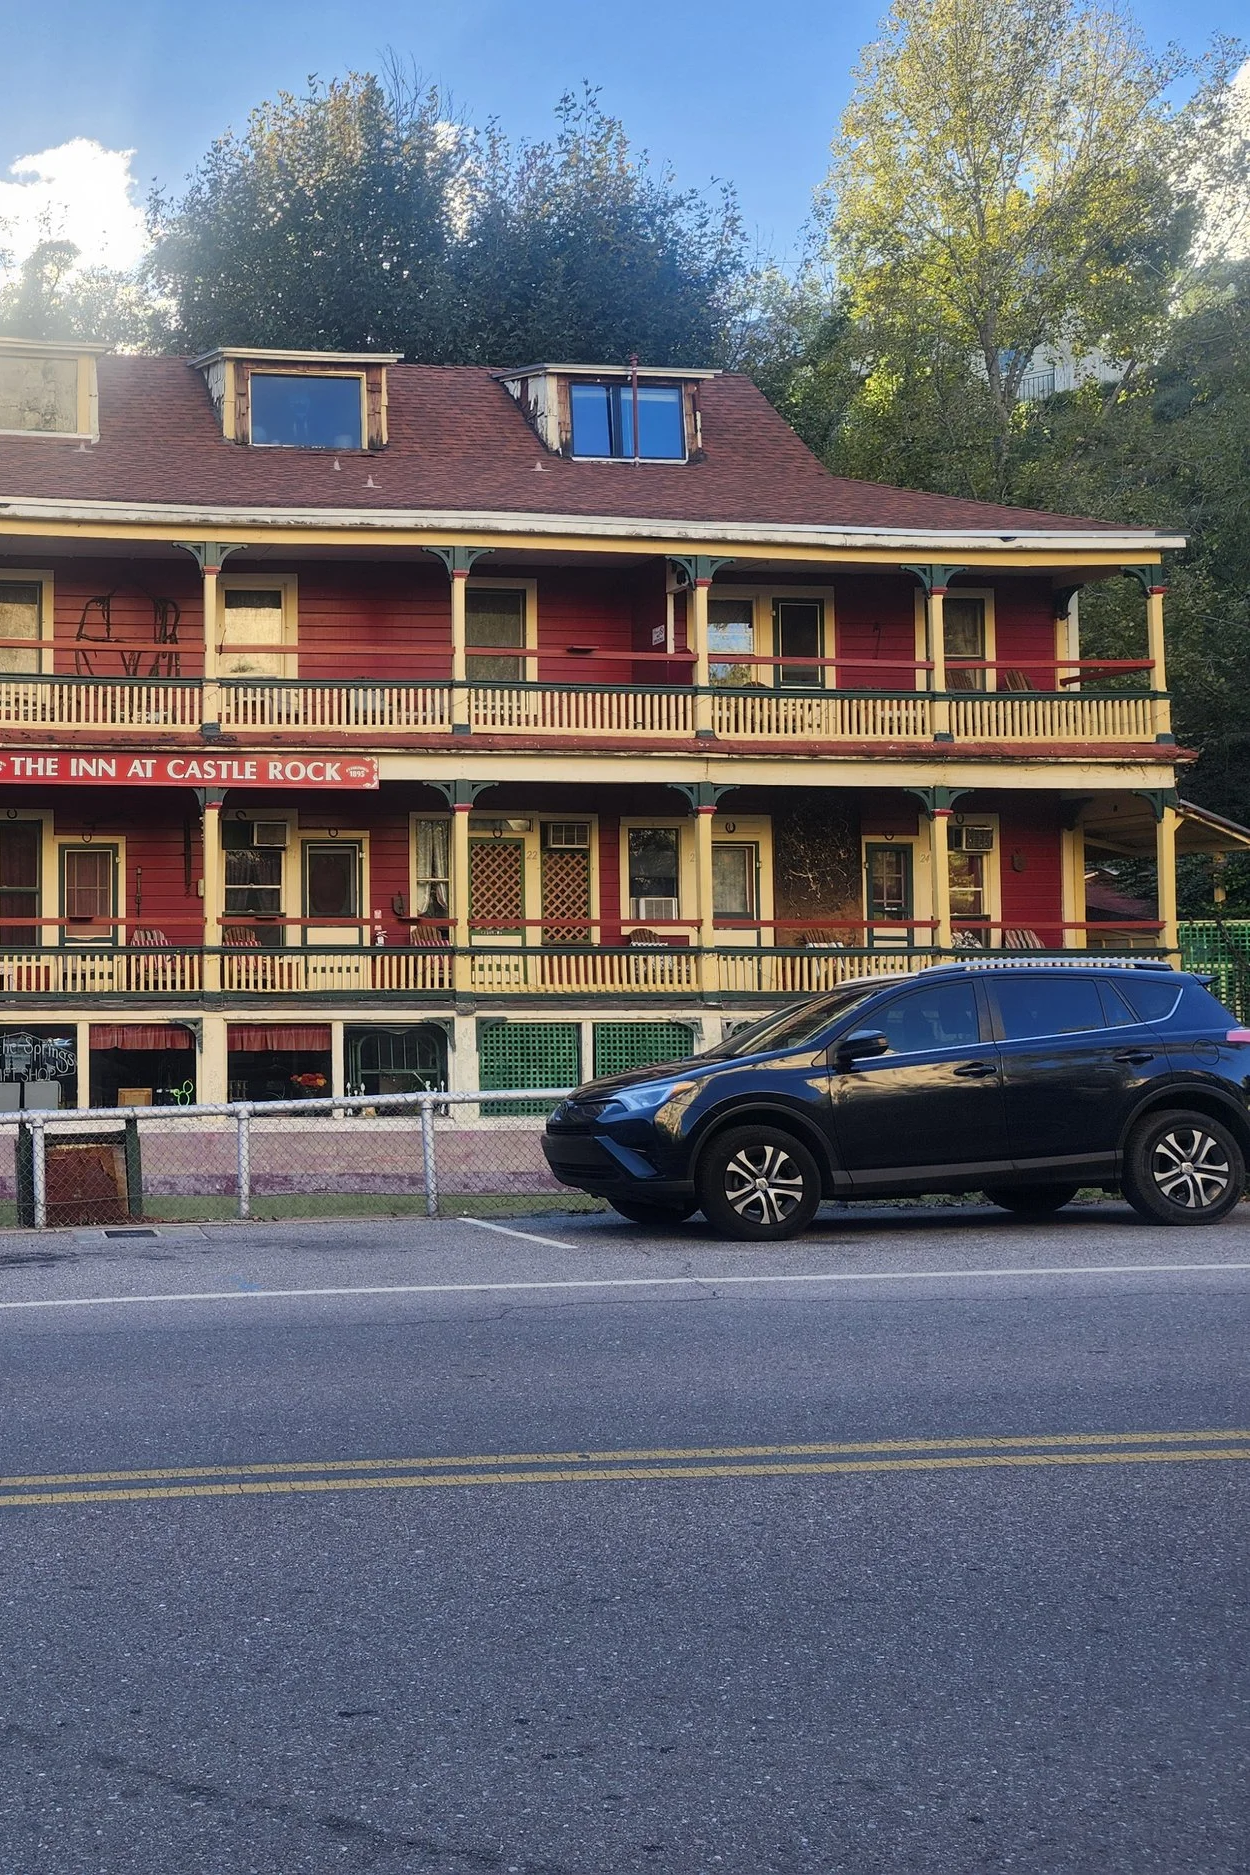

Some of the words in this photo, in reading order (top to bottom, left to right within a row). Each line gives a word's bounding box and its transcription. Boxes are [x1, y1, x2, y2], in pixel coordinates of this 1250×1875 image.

[10, 757, 58, 776] THE
[70, 758, 116, 777] INN
[127, 759, 157, 778] AT
[166, 759, 257, 780] CASTLE
[268, 761, 342, 781] ROCK
[350, 770, 366, 778] 1895
[526, 850, 538, 860] 22
[23, 1036, 75, 1074] Springs
[20, 1067, 57, 1082] SHOP
